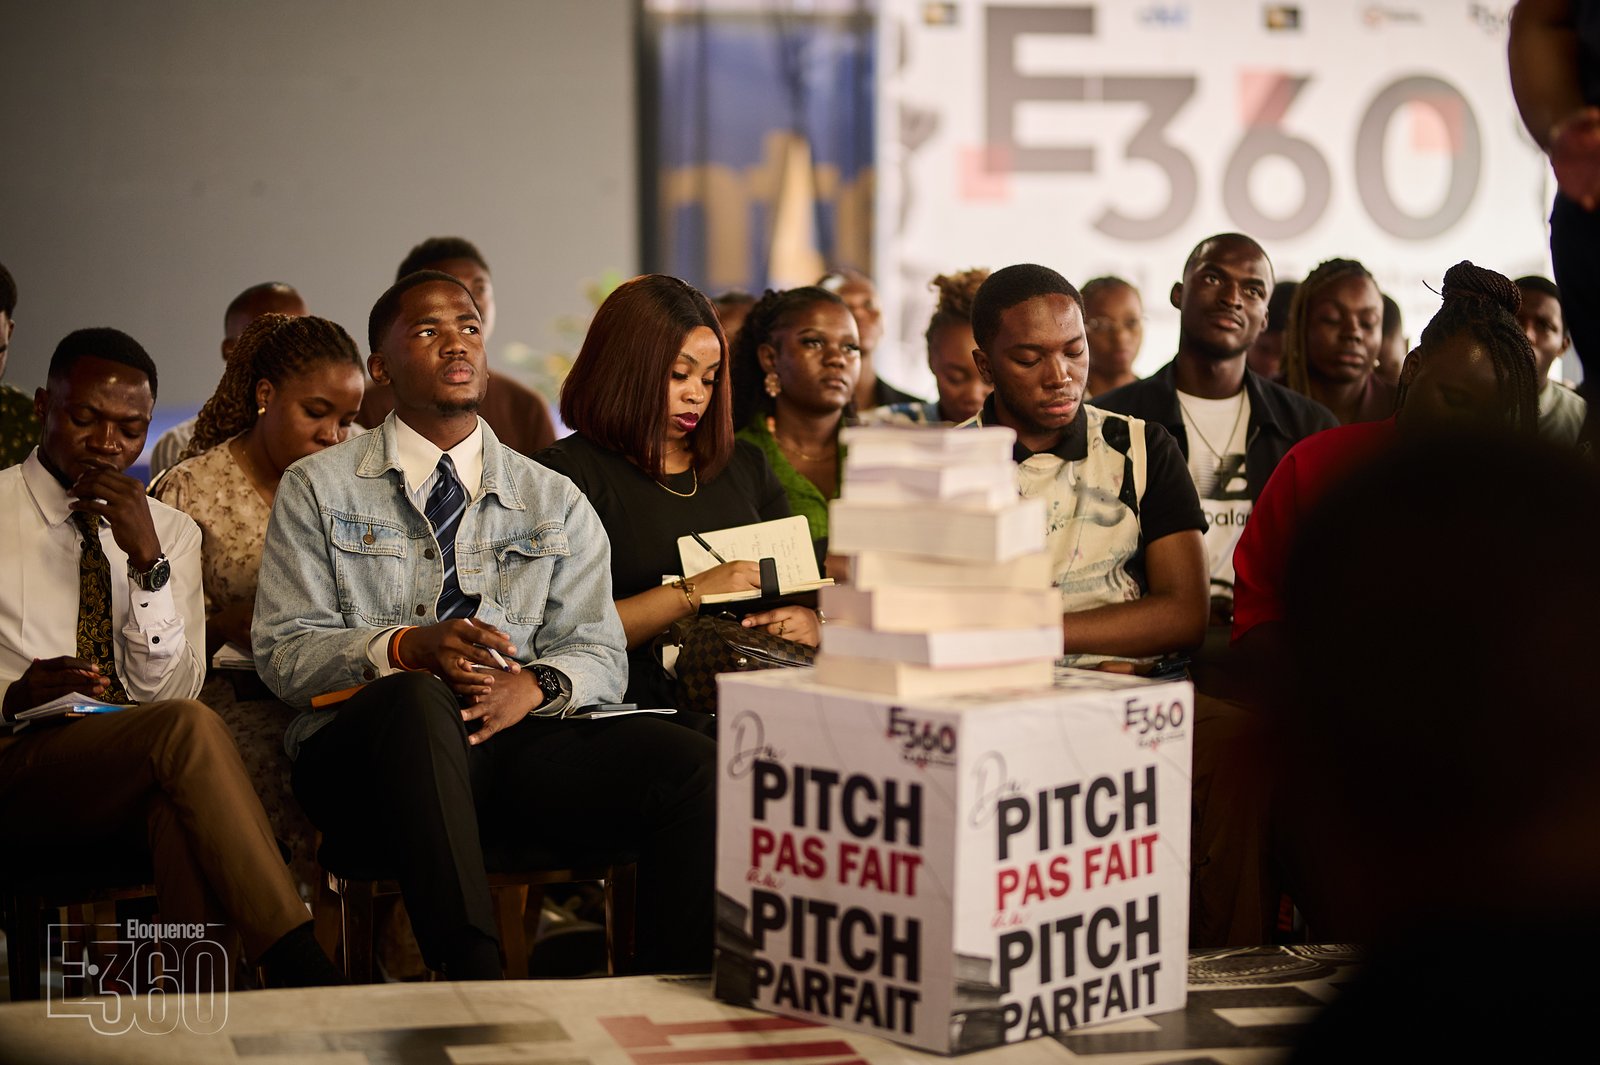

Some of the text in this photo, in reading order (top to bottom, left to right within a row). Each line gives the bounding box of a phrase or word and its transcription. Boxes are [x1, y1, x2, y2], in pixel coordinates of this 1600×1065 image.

[984, 6, 1482, 241] E360
[887, 706, 957, 755] E360
[1123, 698, 1184, 734] E360
[752, 759, 924, 848] PITCH
[997, 765, 1157, 862] PITCH
[751, 827, 924, 897] PAS FAIT
[995, 832, 1159, 912] PAS FAIT
[751, 888, 922, 984] PITCH
[998, 894, 1161, 995] PITCH
[752, 957, 921, 1036] PARFAIT
[999, 961, 1161, 1045] PARFAIT
